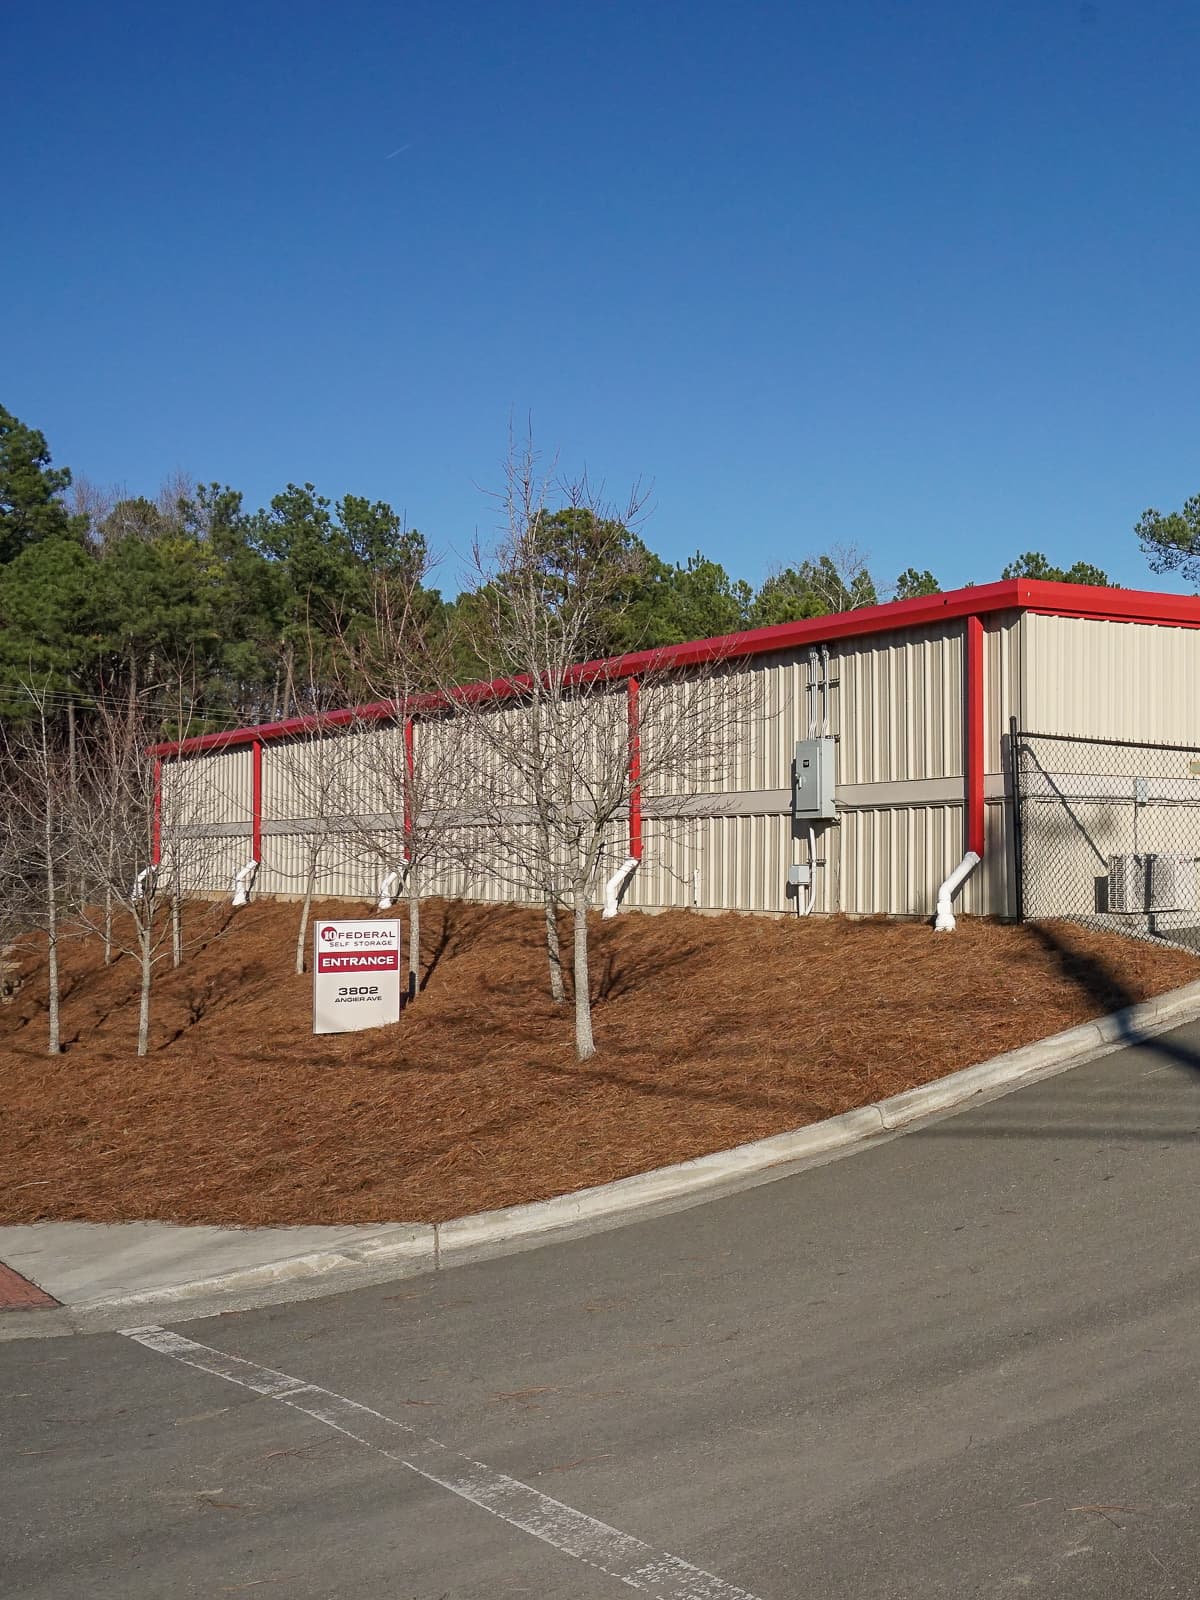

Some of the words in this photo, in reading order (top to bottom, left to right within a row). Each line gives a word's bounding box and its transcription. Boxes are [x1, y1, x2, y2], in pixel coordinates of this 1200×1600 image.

[324, 930, 337, 942] 10
[338, 931, 396, 939] FEDERAL
[322, 956, 395, 967] ENTRANCE
[338, 986, 379, 996] 3802
